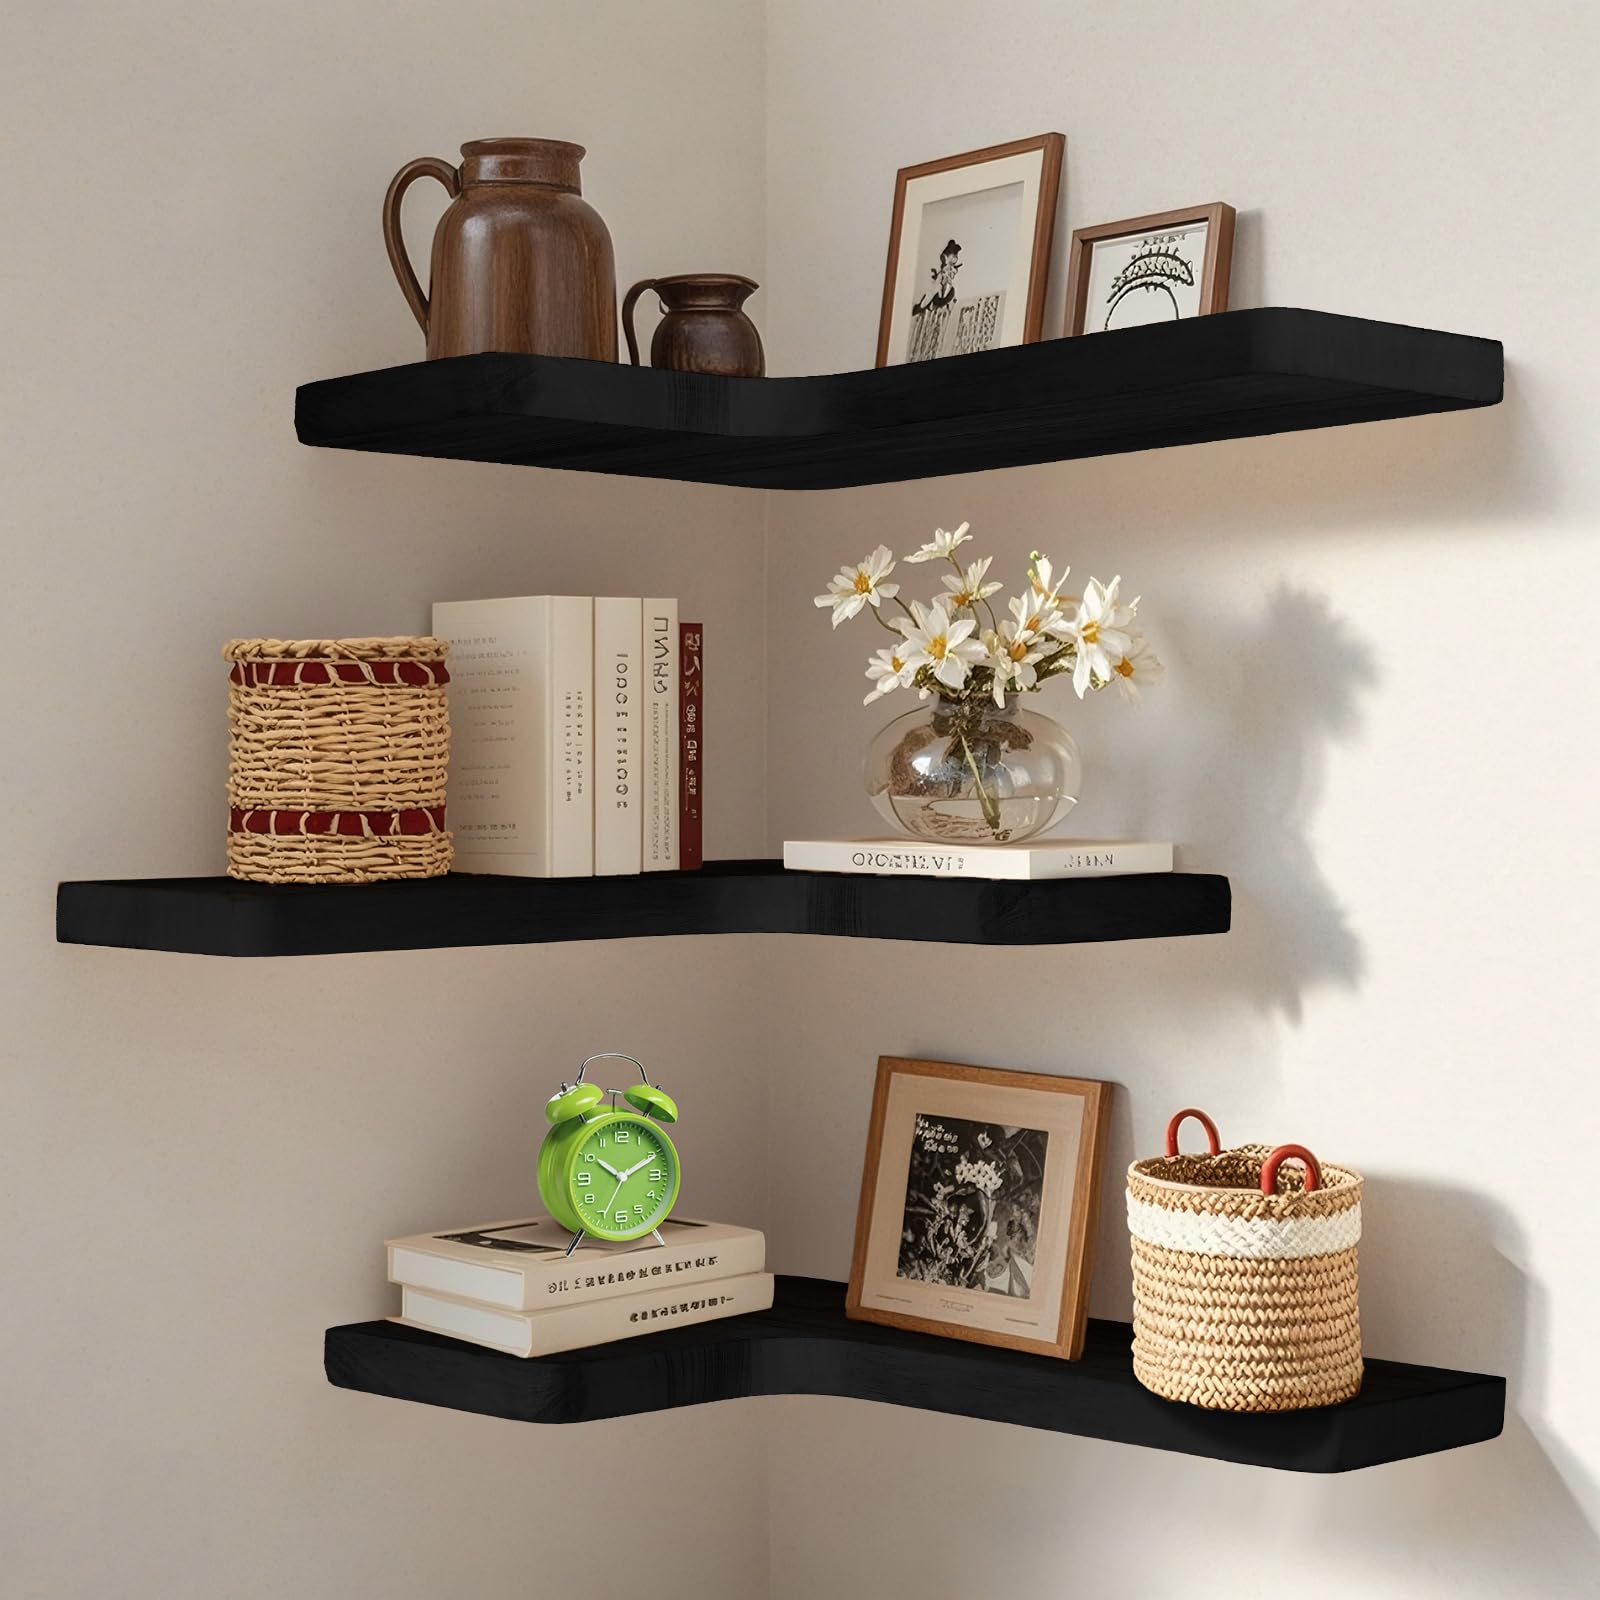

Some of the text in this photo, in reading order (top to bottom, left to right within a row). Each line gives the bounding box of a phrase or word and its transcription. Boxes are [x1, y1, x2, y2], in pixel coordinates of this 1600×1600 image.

[614, 1131, 629, 1143] 12
[637, 1136, 641, 1146] 1
[600, 1139, 606, 1148] 11
[584, 1153, 596, 1162] 10
[577, 1172, 591, 1186] 9
[649, 1169, 661, 1181] 3
[585, 1194, 594, 1203] 8
[647, 1190, 655, 1199] 4
[634, 1205, 643, 1214] 5
[615, 1210, 628, 1223] 6
